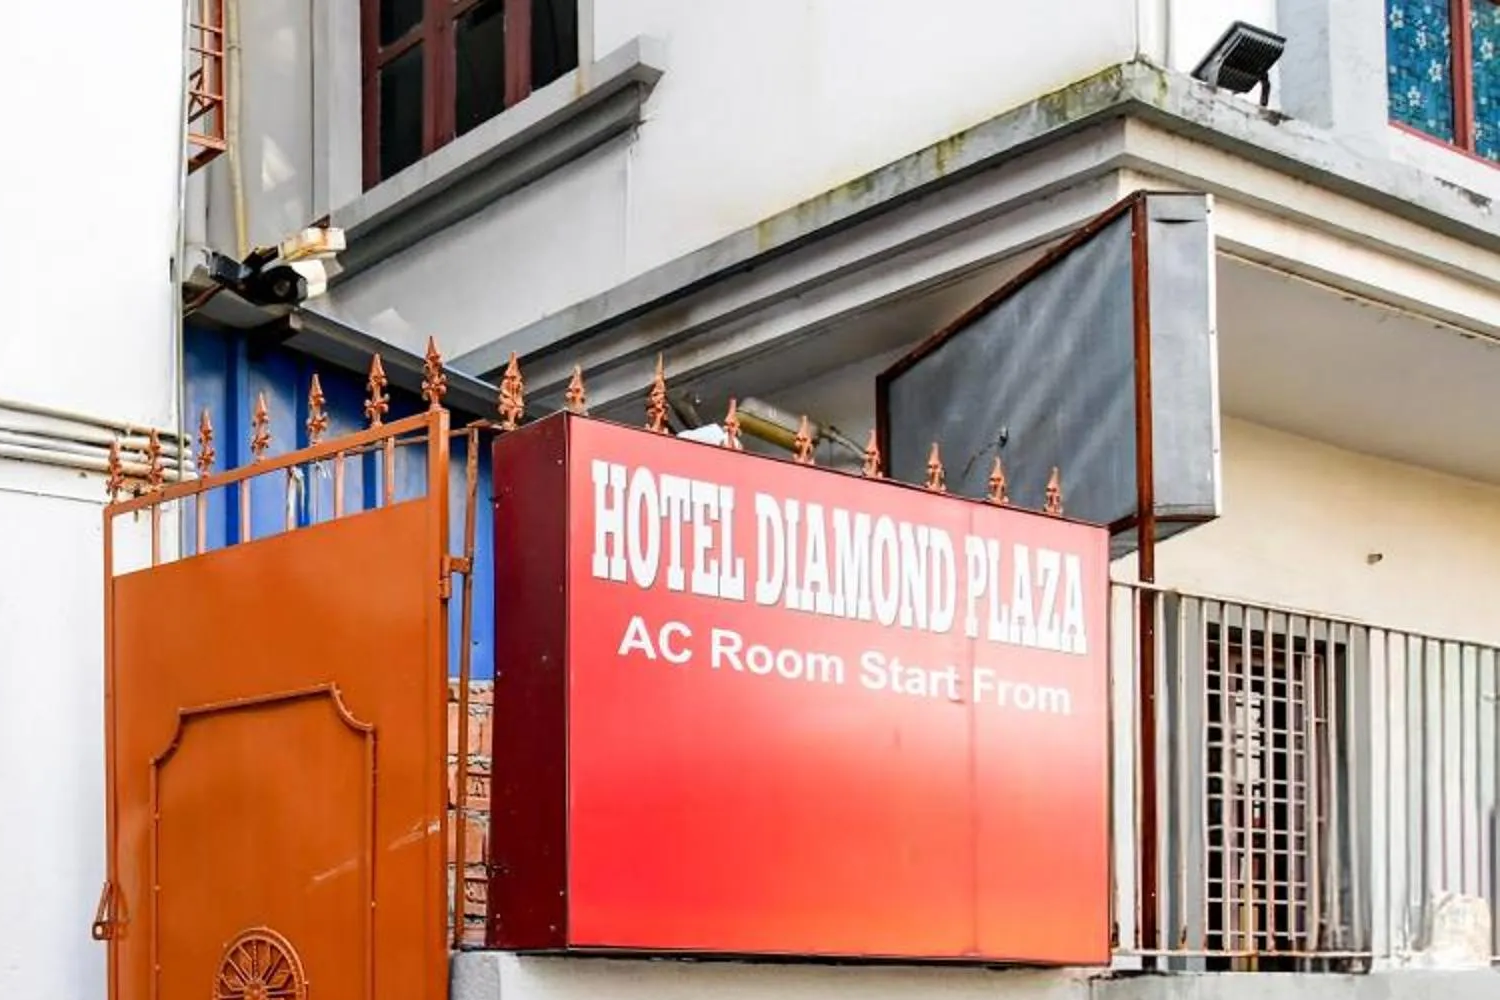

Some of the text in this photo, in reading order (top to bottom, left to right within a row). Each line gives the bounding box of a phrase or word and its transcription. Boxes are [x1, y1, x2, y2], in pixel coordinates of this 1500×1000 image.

[591, 459, 1088, 656] HOTEL DIAMOND PLAZA
[618, 614, 1071, 716] AC Room Start From
